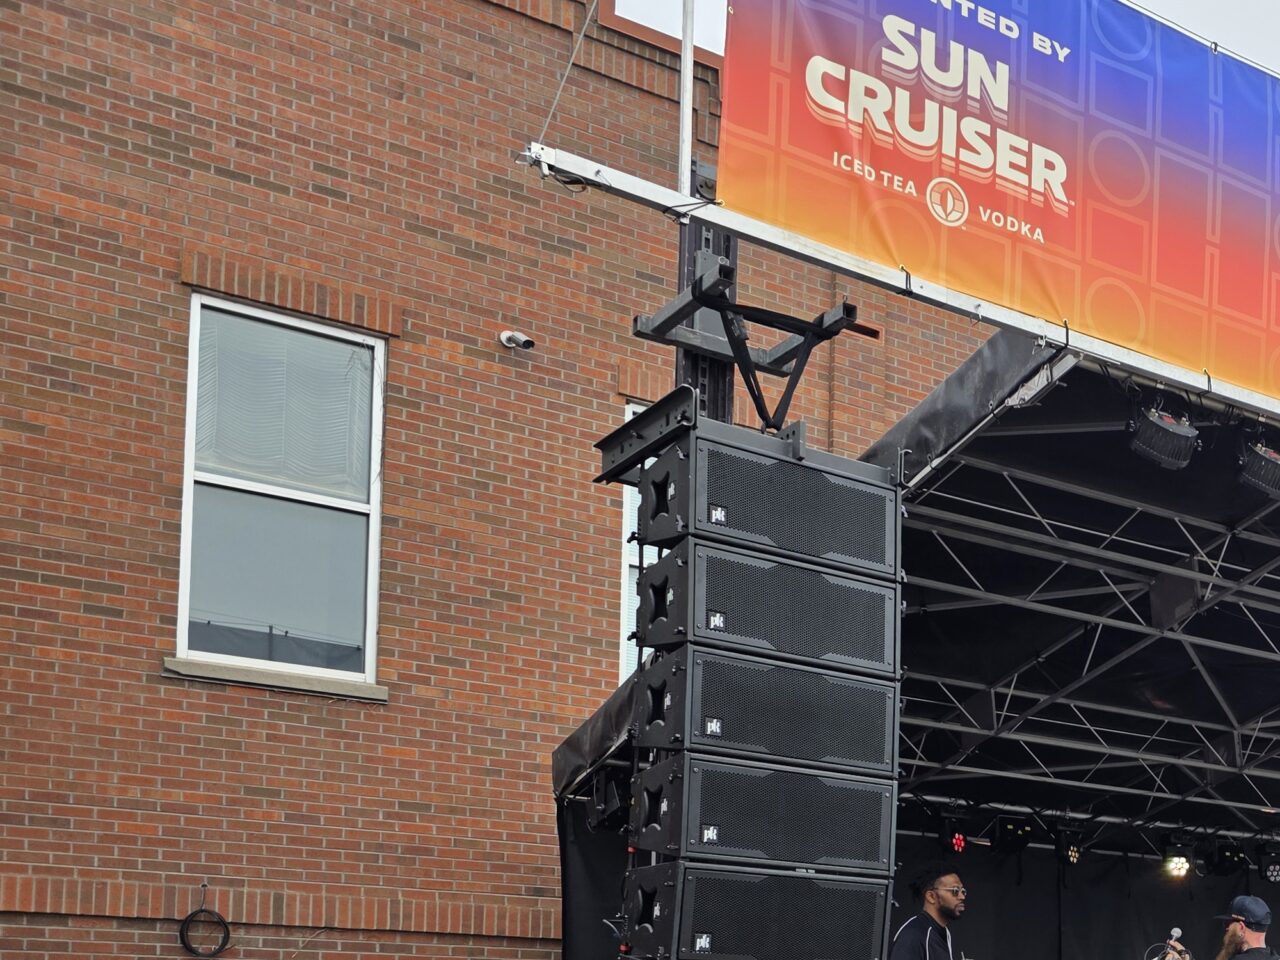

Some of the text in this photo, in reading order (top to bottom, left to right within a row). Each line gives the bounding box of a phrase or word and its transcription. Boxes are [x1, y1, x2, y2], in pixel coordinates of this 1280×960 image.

[1033, 31, 1071, 62] BY
[881, 14, 1010, 114] SUN
[804, 55, 1070, 208] CRUISER
[832, 151, 918, 197] ICED TEA
[978, 206, 1045, 244] VODKA
[711, 507, 726, 527] pk
[709, 613, 724, 632] pk
[707, 719, 721, 736] pk
[703, 826, 718, 843] pk
[695, 934, 710, 951] pk
